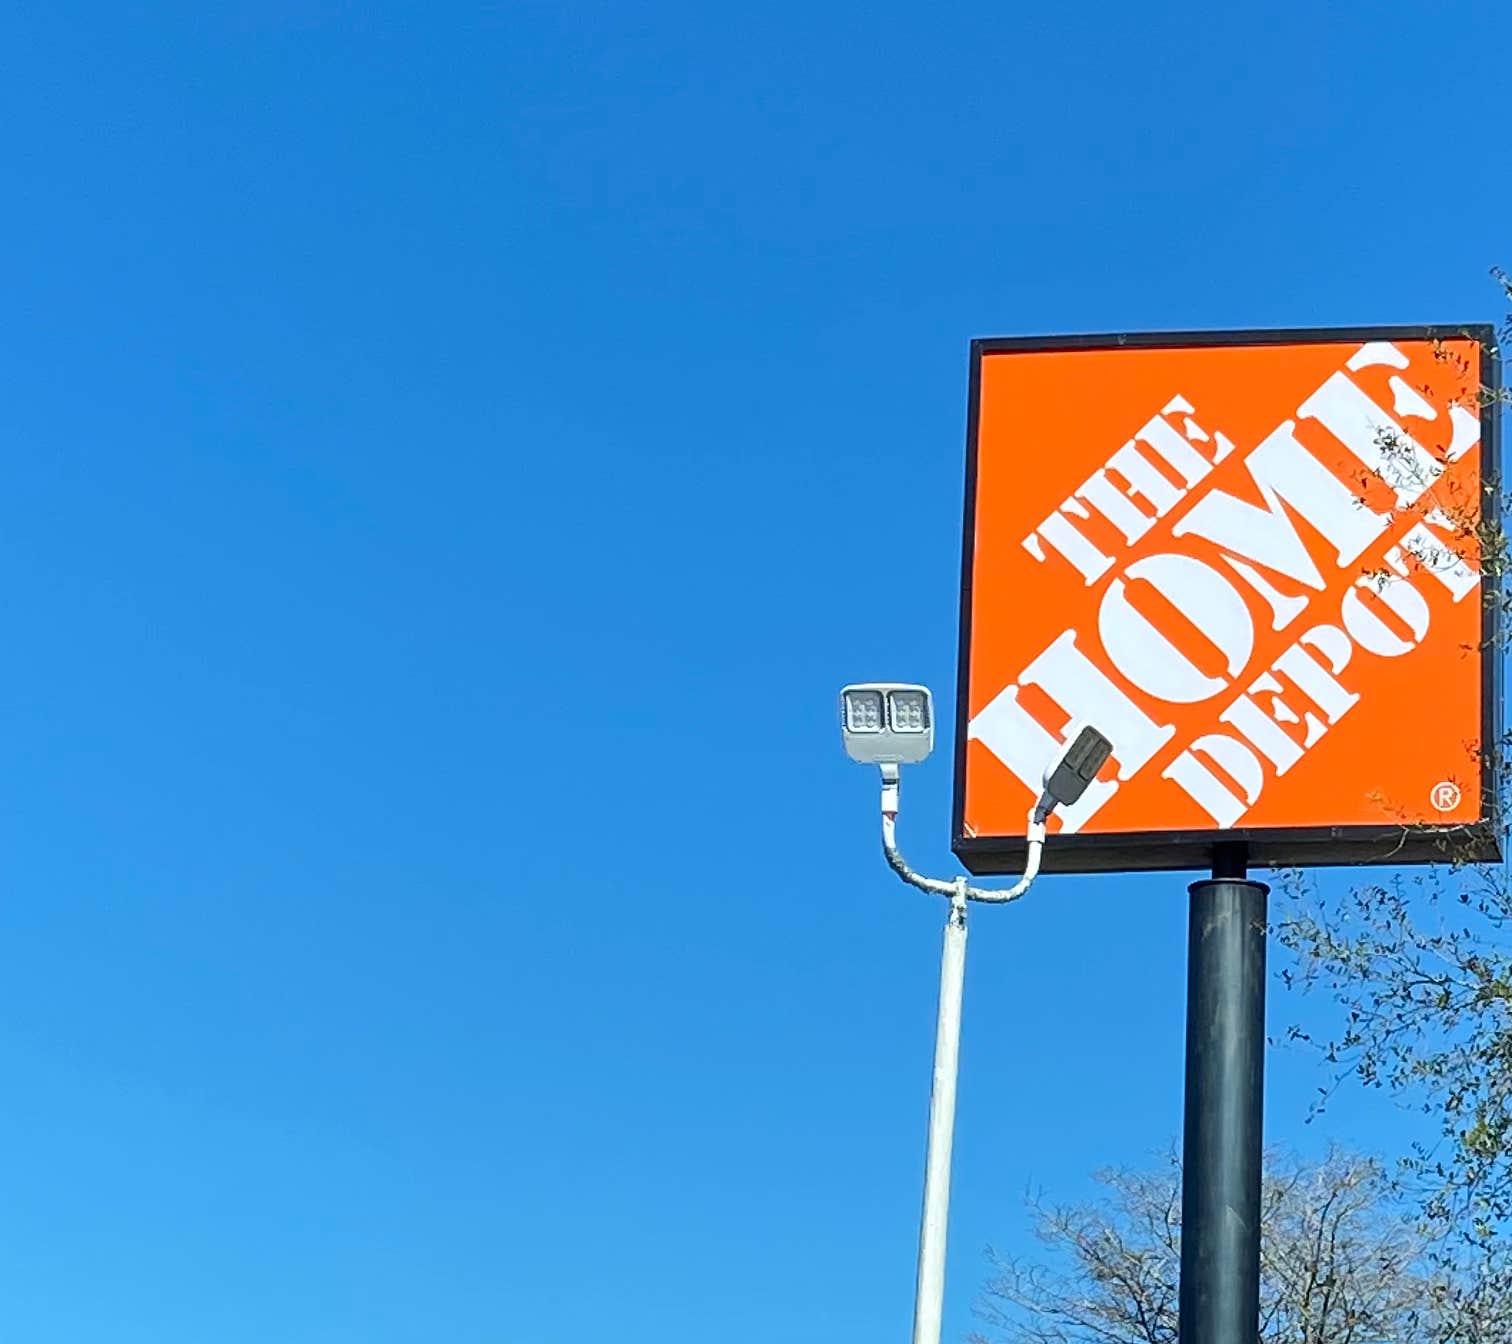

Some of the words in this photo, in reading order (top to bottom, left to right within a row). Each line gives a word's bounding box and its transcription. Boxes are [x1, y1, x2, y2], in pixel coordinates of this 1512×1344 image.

[968, 341, 1481, 834] HOME
[1020, 393, 1236, 587] THE
[1162, 505, 1481, 829] DEPOT
